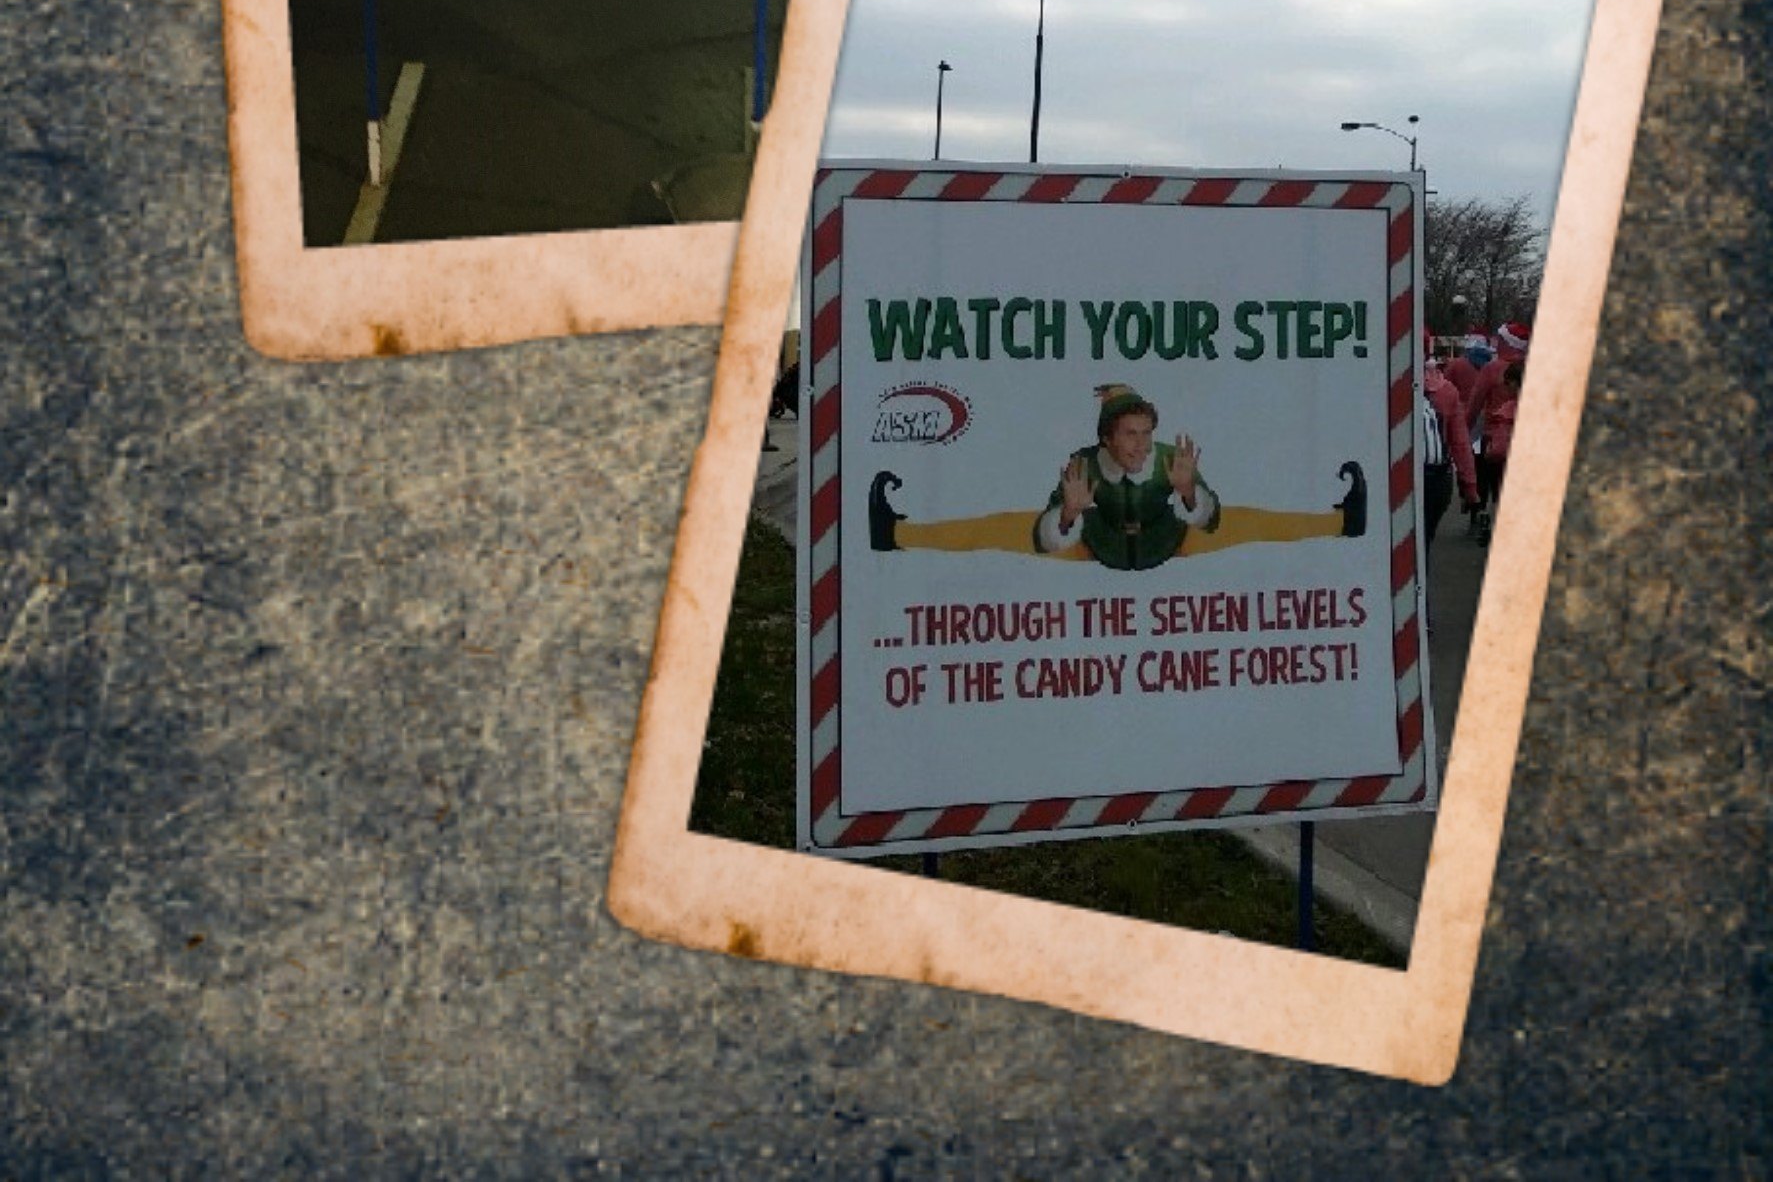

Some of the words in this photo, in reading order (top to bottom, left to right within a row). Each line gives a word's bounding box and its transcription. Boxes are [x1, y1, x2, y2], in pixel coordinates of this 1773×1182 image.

[865, 297, 1066, 362] WATCH
[1080, 299, 1219, 361] YOUR
[1234, 300, 1368, 359] STEP!
[873, 601, 1066, 648] ...THROUGH
[1076, 597, 1135, 638] THE
[1151, 592, 1249, 636] SEVEN
[1259, 587, 1367, 629] LEVELS
[886, 666, 926, 707] OF
[941, 662, 1004, 704] THE
[1015, 654, 1126, 699] CANDY
[1136, 649, 1220, 694] CANE
[1229, 643, 1359, 686] FOREST!
